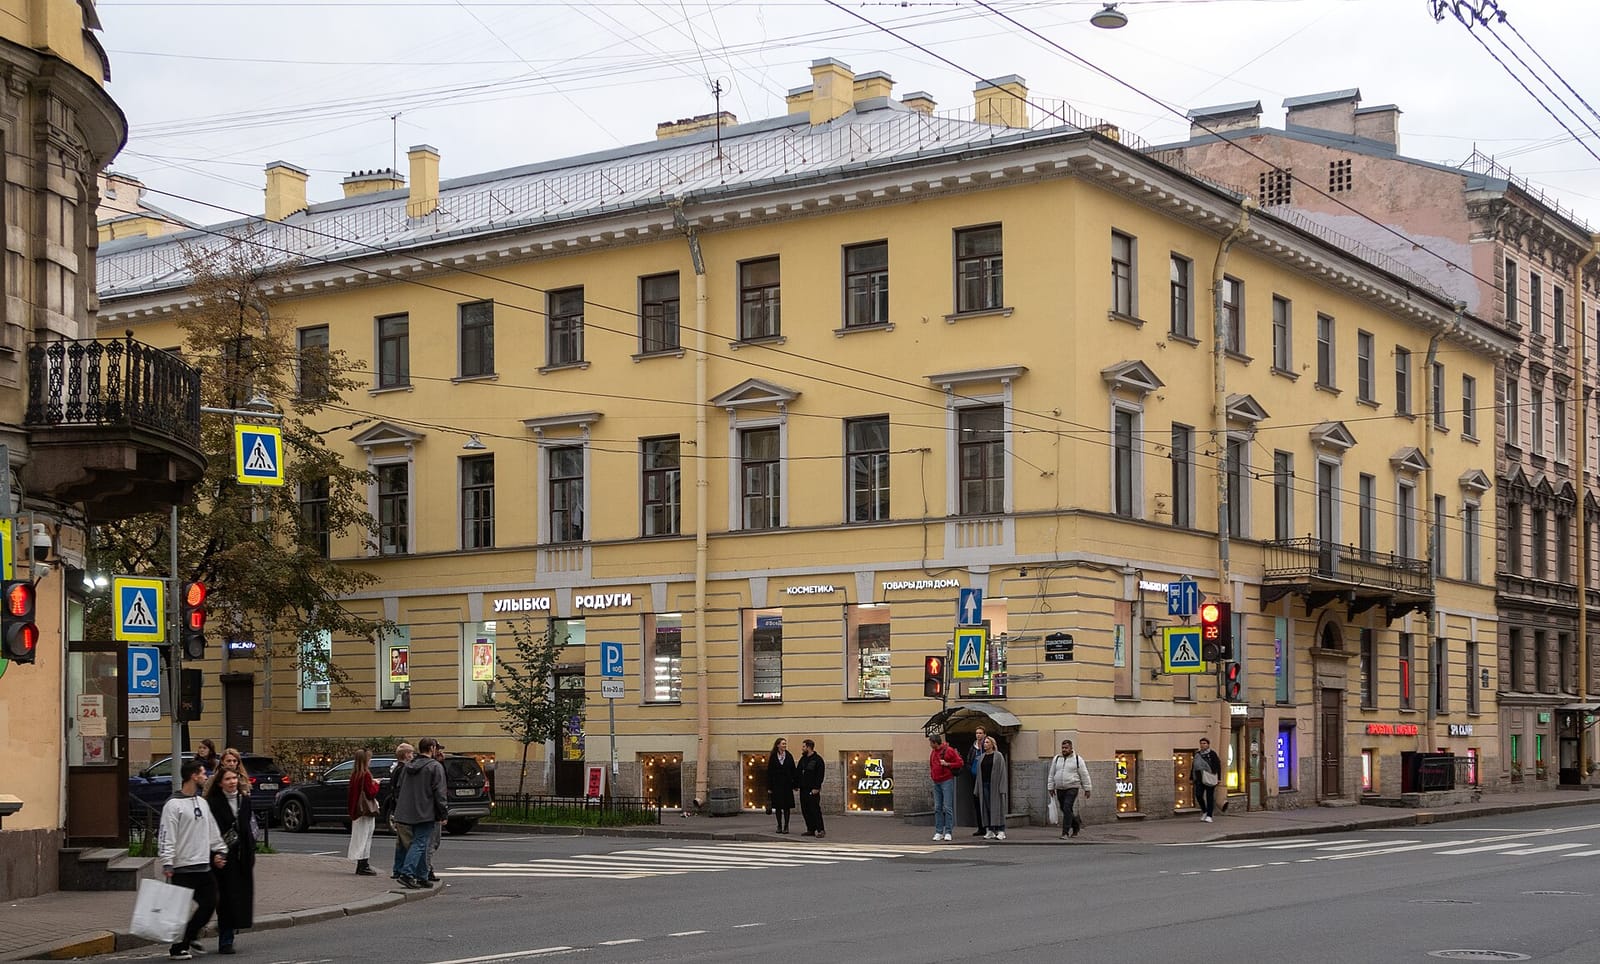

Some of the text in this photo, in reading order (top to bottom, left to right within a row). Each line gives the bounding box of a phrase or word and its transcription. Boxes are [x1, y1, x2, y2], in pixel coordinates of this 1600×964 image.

[787, 585, 834, 594] КОСМЕТИКА
[882, 579, 959, 590] ТОВАРЫ ДЛЯ ДОМА
[1206, 626, 1218, 639] 22
[607, 645, 619, 673] P
[133, 652, 153, 689] P
[83, 708, 98, 718] 24
[128, 705, 159, 714] .00-20.00
